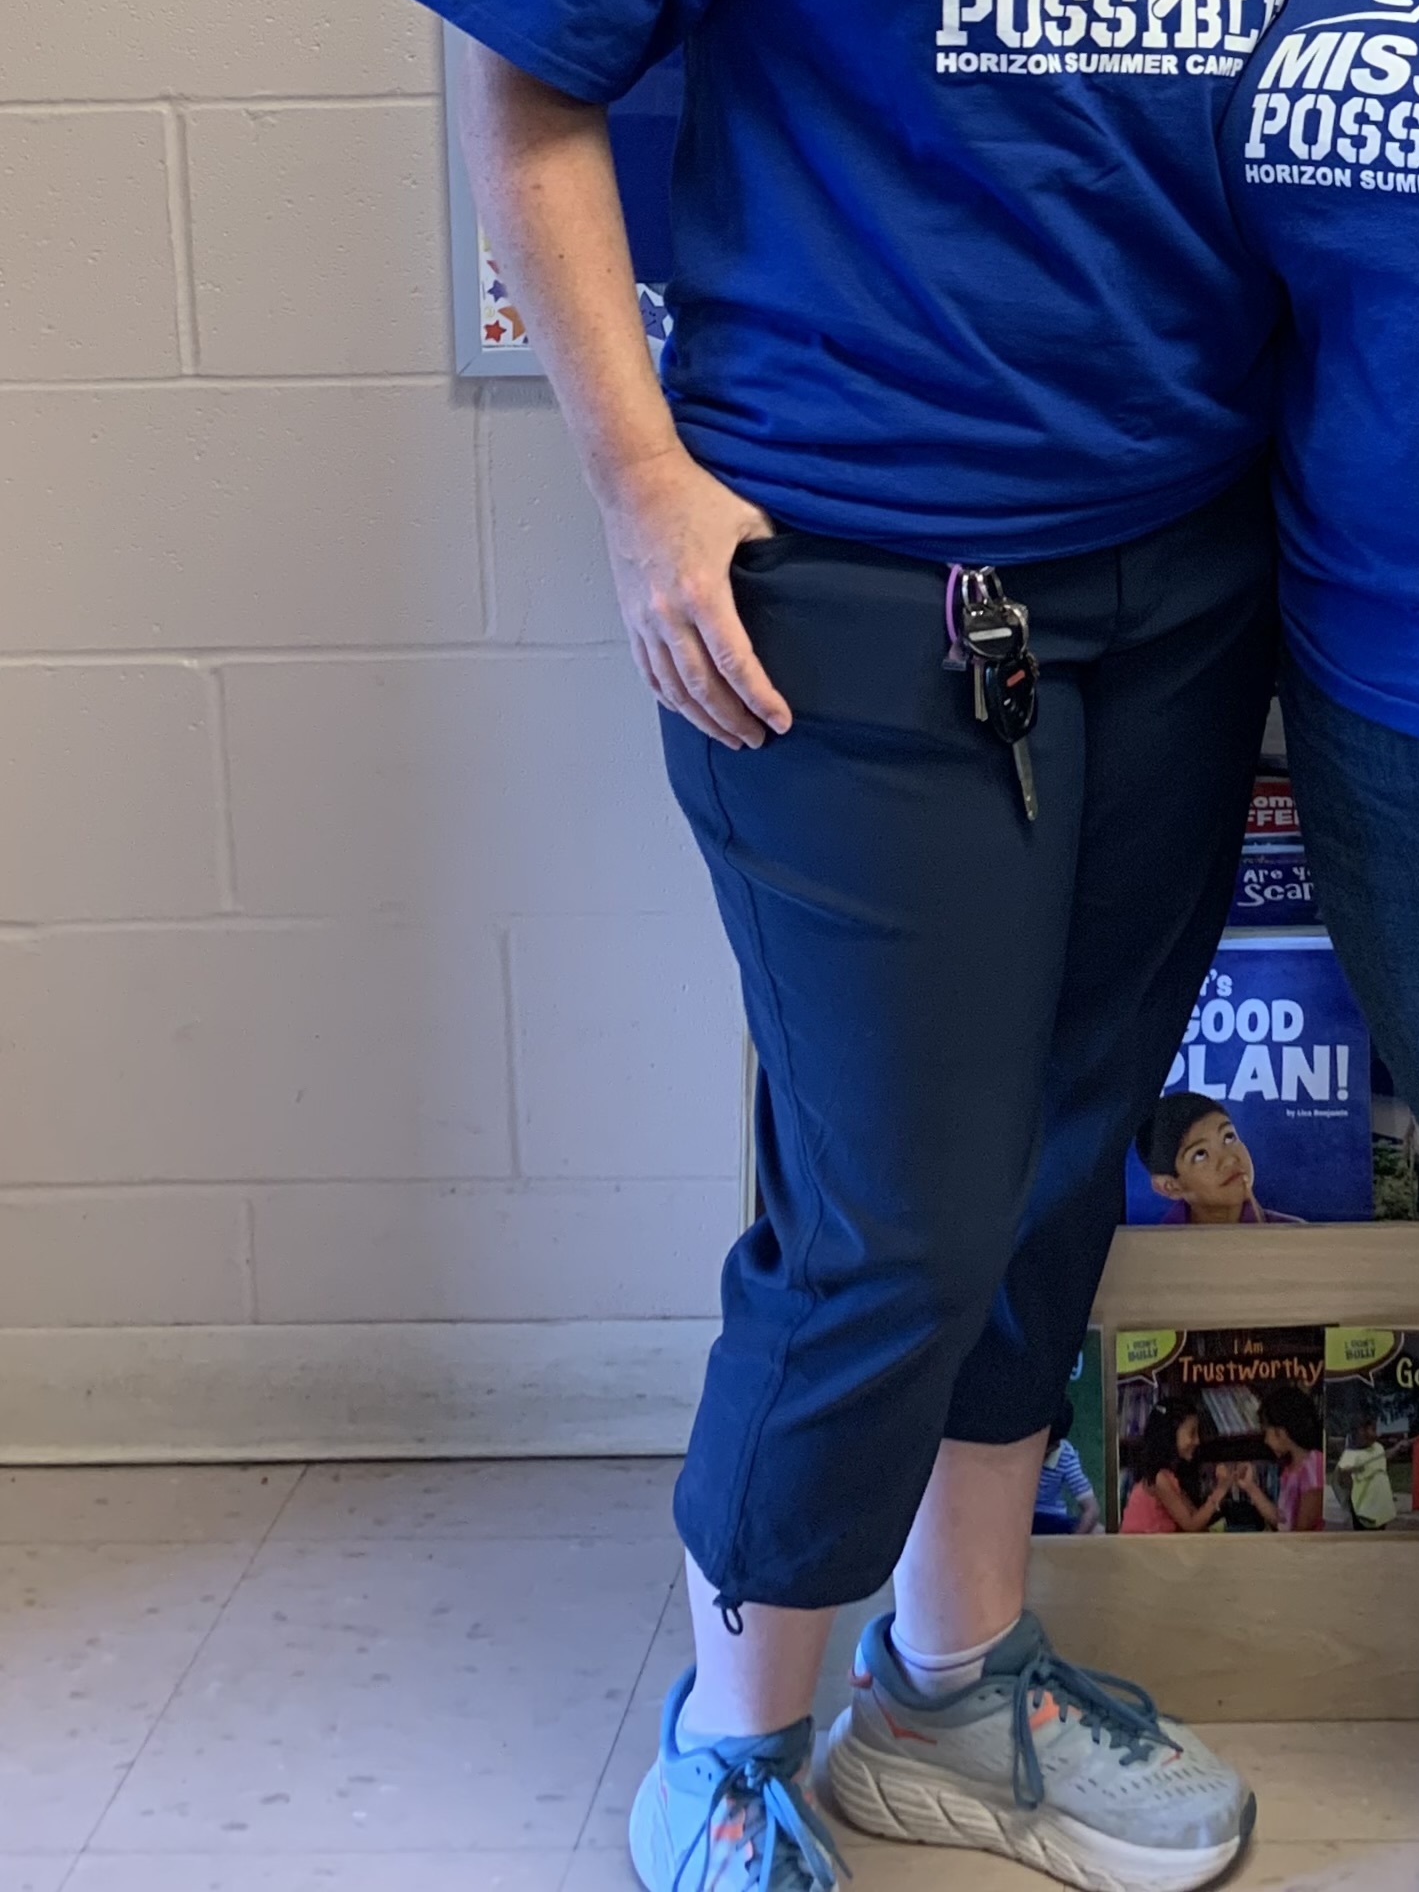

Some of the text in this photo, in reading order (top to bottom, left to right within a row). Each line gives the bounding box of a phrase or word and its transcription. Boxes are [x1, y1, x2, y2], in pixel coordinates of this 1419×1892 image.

[936, 52, 1244, 78] HORIZON SUMMER CAMP
[1245, 164, 1351, 188] HORIZON
[1250, 795, 1296, 808] om
[1234, 1339, 1264, 1355] I Am
[1178, 1355, 1324, 1386] Trustworthy
